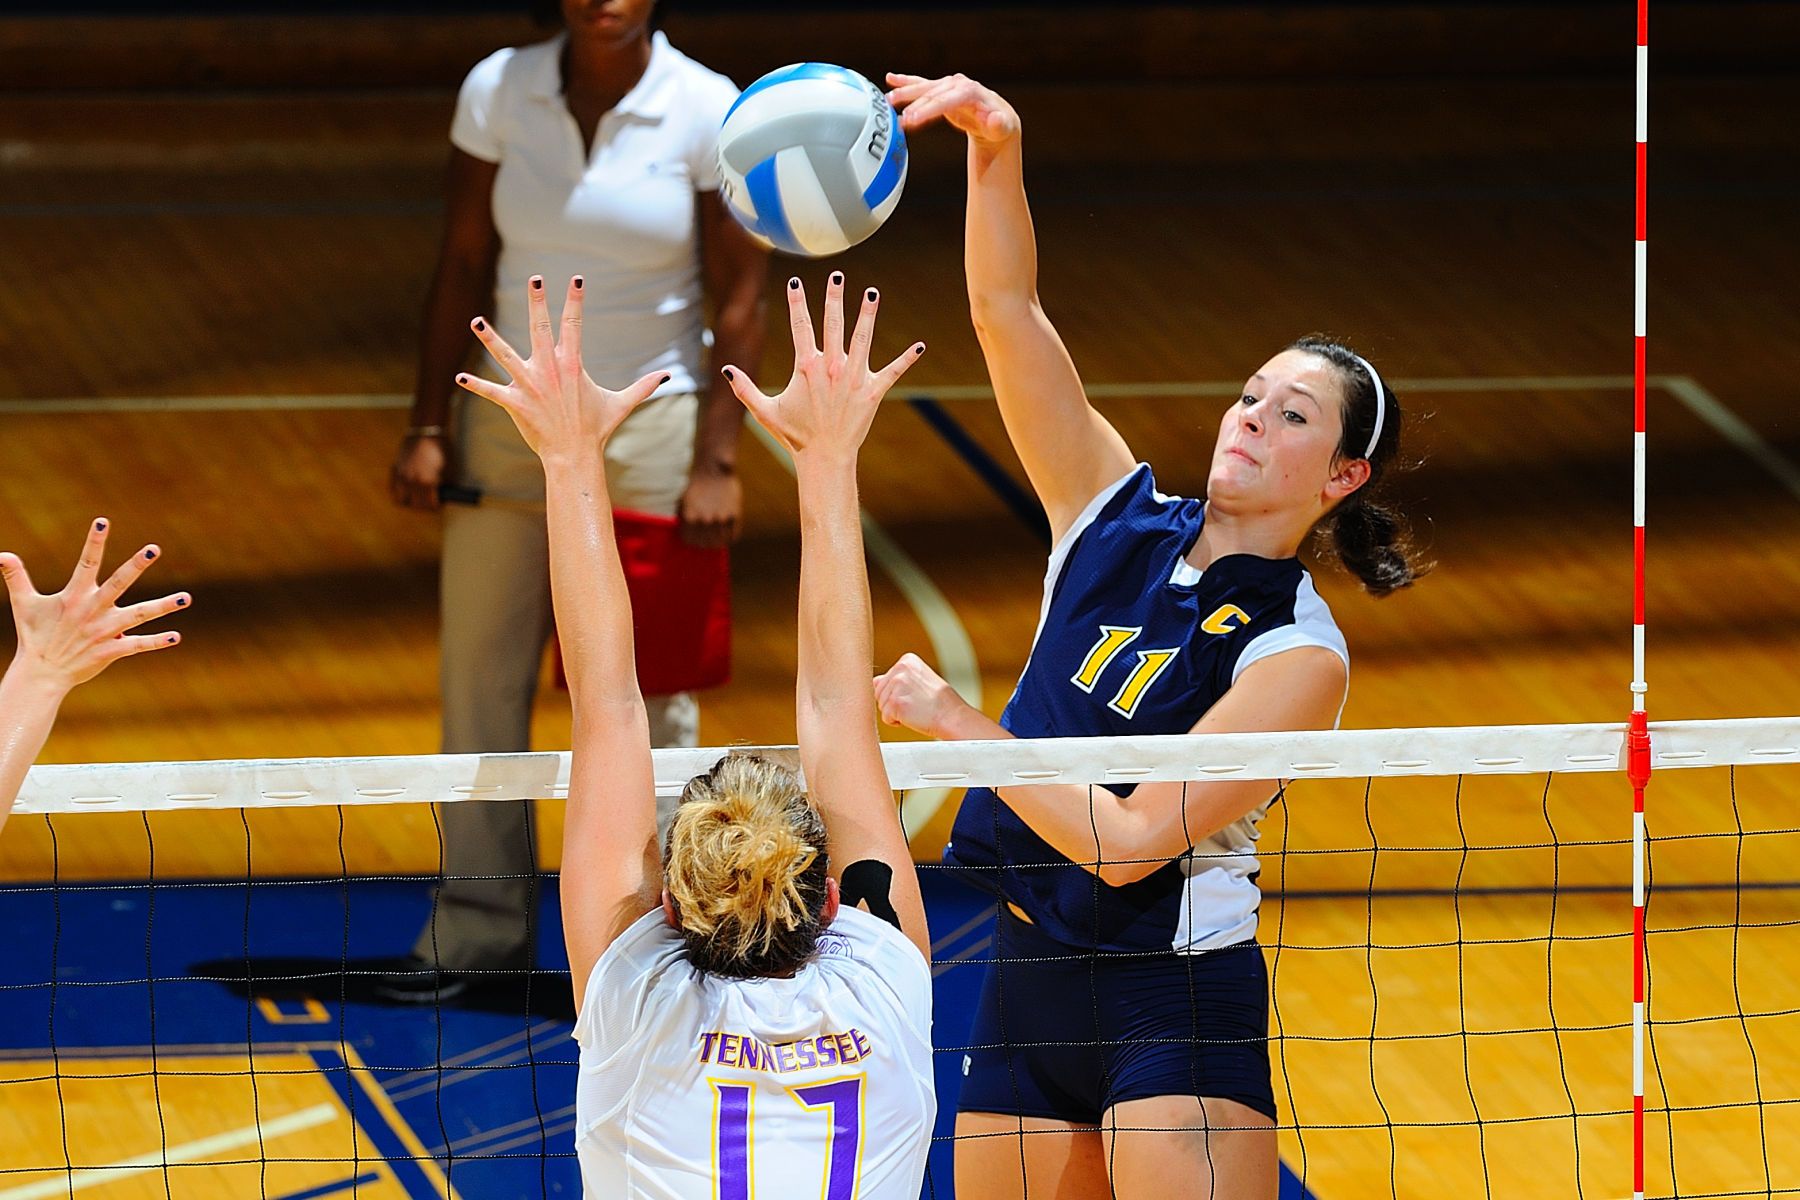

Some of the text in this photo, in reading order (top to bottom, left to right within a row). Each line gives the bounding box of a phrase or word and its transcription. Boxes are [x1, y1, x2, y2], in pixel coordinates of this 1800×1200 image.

[1201, 603, 1251, 634] C
[1070, 625, 1181, 720] 11
[699, 1028, 872, 1074] TENNESSEE
[706, 1072, 867, 1200] 17
